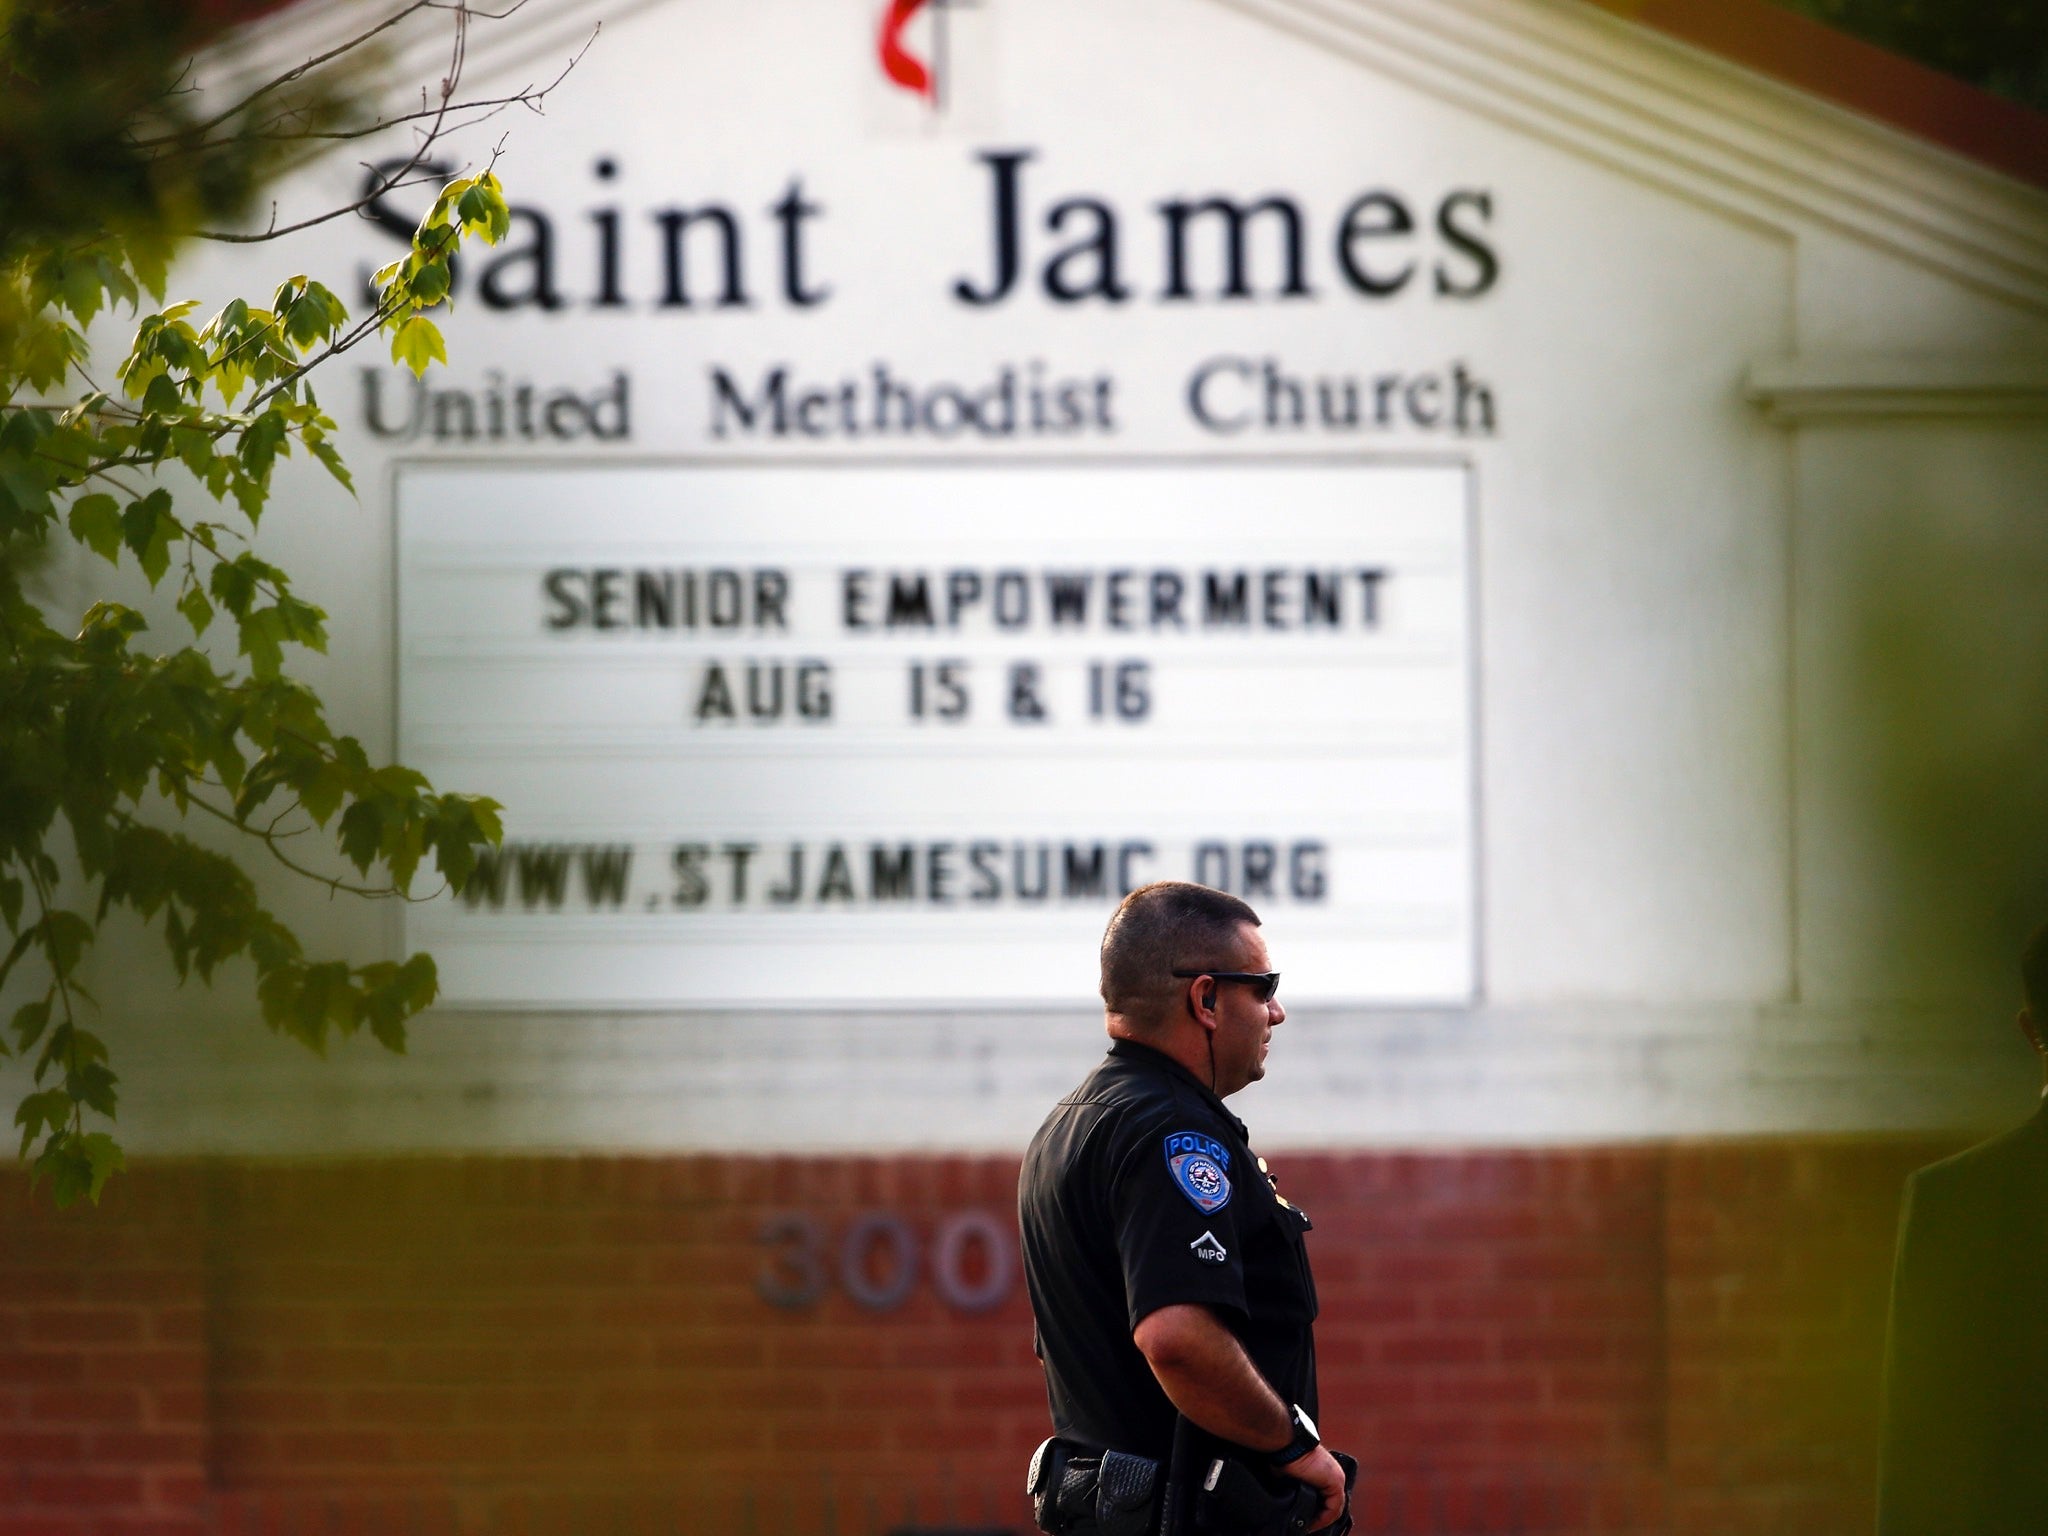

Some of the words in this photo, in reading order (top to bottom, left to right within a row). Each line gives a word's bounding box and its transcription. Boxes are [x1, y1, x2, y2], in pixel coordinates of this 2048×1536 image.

[355, 157, 832, 311] Saint
[951, 148, 1503, 308] James
[359, 366, 632, 439] United
[708, 361, 1116, 437] Methodist
[1187, 356, 1496, 436] Church
[542, 567, 791, 632] SENIOR
[842, 567, 1391, 631] EMPOWERMENT
[694, 658, 834, 721] AUG
[909, 658, 971, 721] 15
[1006, 660, 1048, 724] &
[1087, 658, 1154, 722] 16
[459, 838, 1328, 913] WWW.STJAMESUMCORG
[1169, 1136, 1231, 1173] POLICE
[757, 1210, 1014, 1312] 300
[1197, 1248, 1225, 1262] MPO
